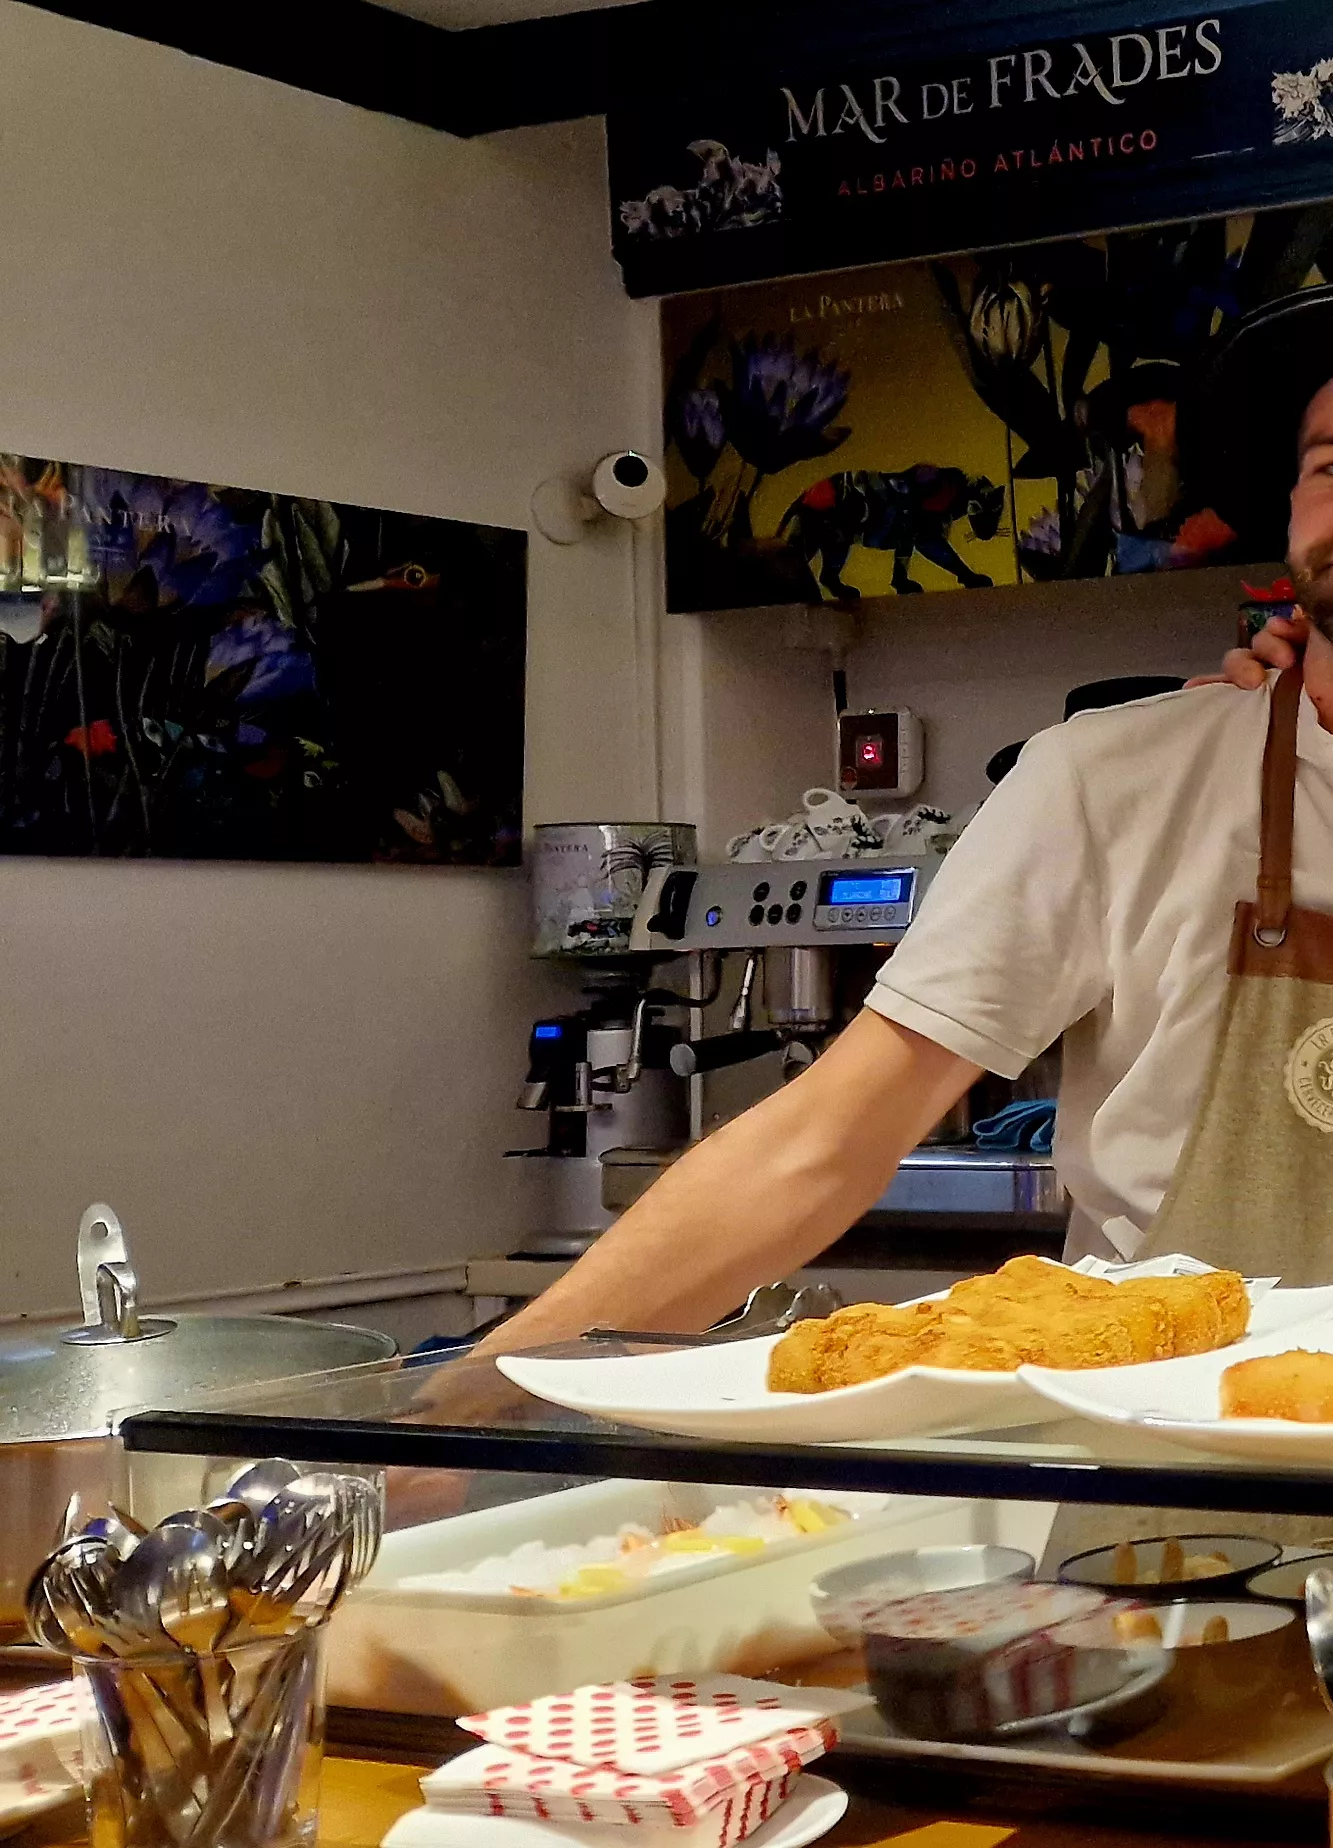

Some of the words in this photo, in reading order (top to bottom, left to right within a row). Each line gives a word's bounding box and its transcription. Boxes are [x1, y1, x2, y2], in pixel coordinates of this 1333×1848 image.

[779, 74, 911, 145] MAR
[920, 76, 975, 121] DE
[986, 17, 1223, 110] FRADES
[836, 155, 977, 198] ALBARIÑO
[992, 127, 1160, 173] ATLÁNTICO
[1310, 1033, 1330, 1051] LA
